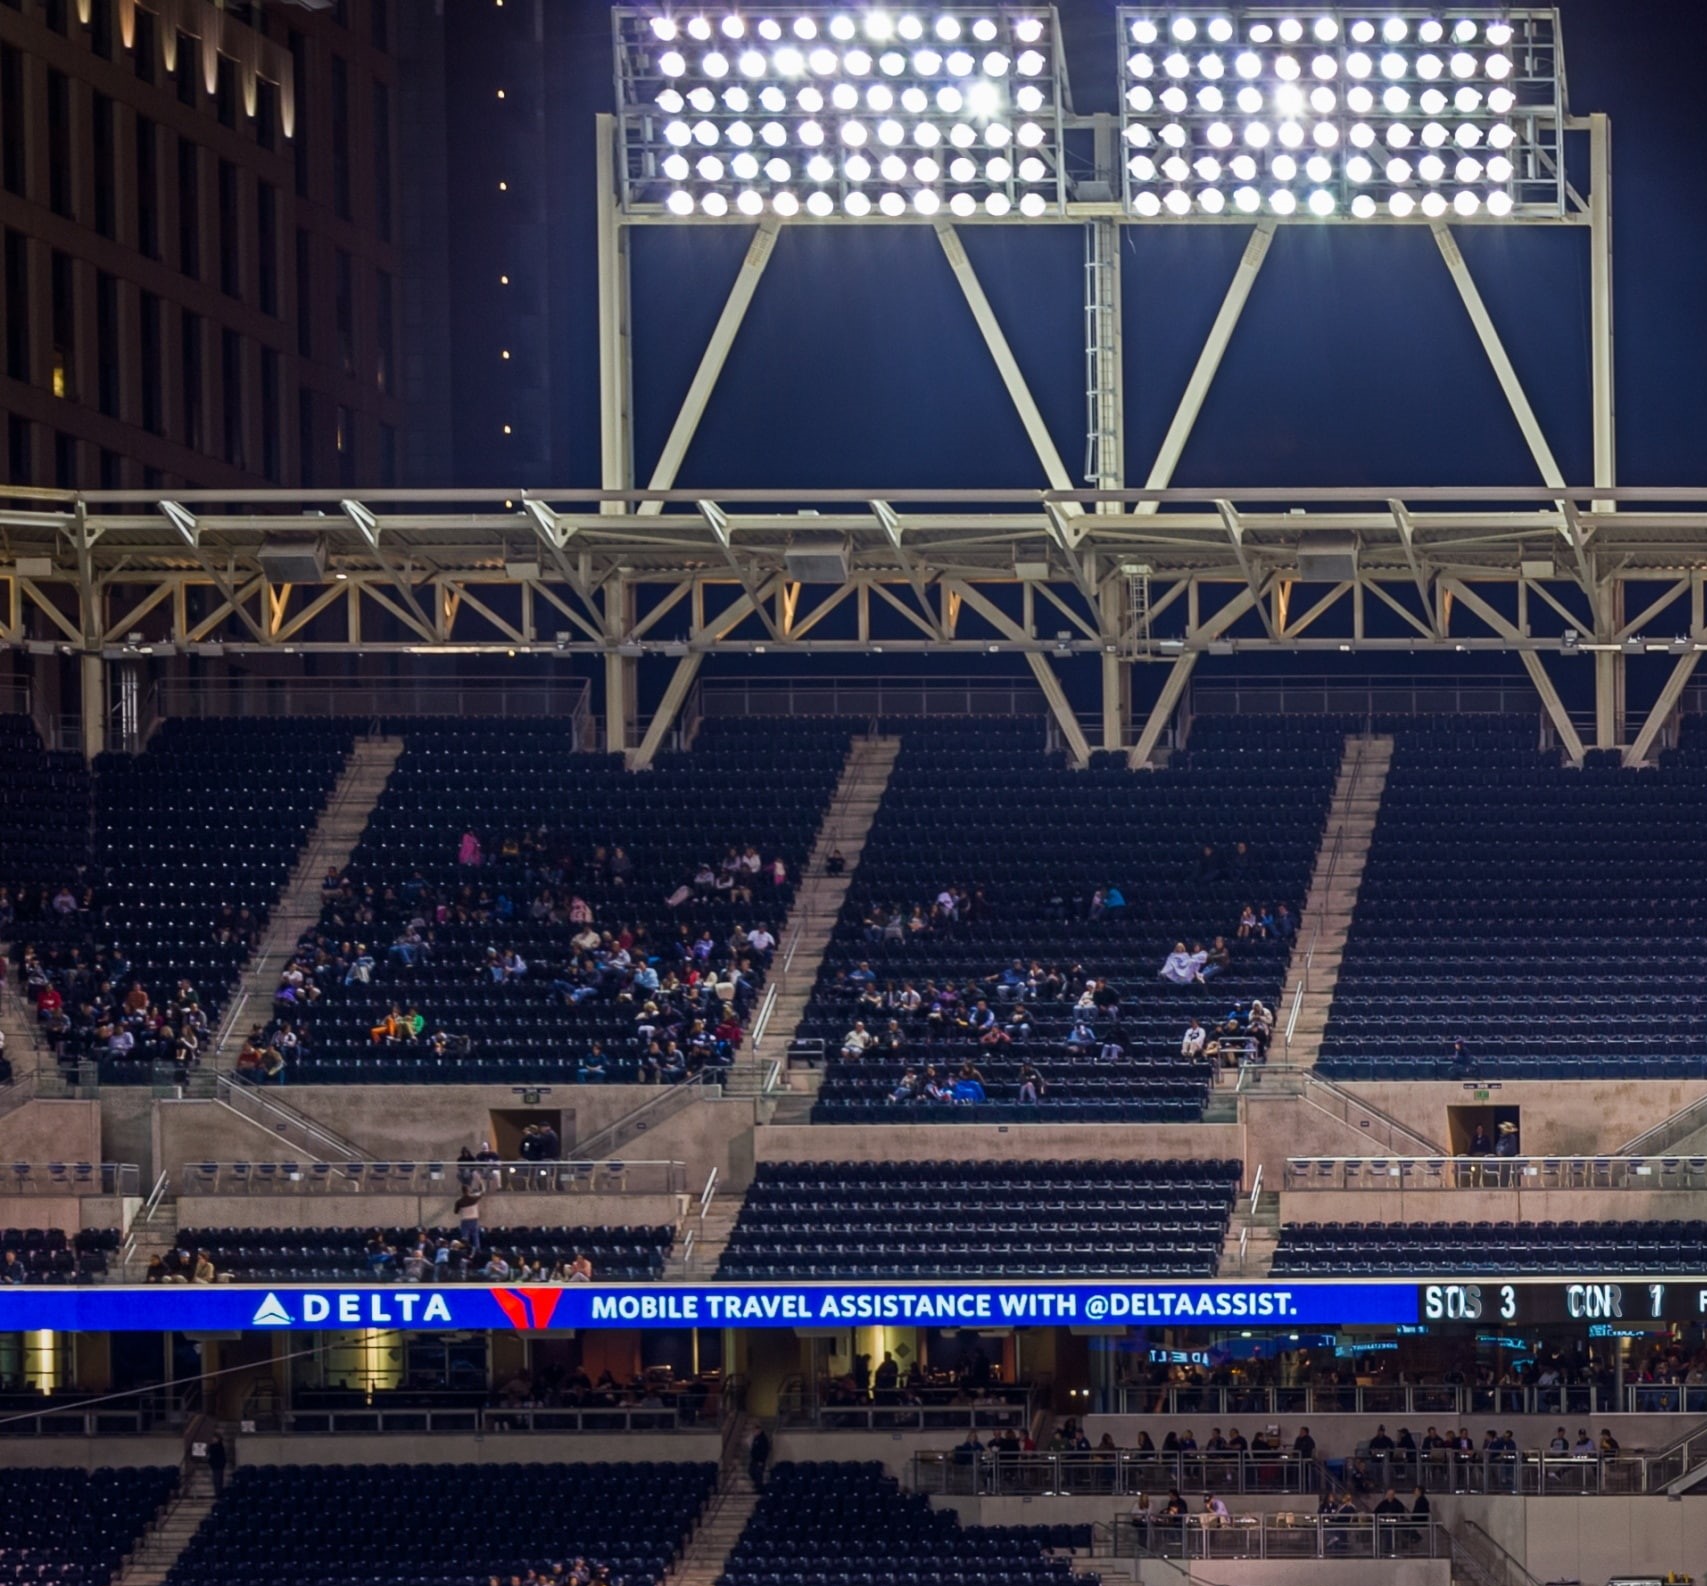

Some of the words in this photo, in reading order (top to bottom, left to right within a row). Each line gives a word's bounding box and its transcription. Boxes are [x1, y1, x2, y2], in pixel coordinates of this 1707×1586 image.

[302, 1293, 452, 1323] DELTA
[592, 1297, 698, 1318] MOBILE
[705, 1296, 811, 1318] TRAVEL
[820, 1293, 992, 1317] ASSISTANCE
[1000, 1293, 1077, 1318] WITH
[1085, 1292, 1297, 1320] @DELTAASSIST.
[1500, 1285, 1516, 1319] 3
